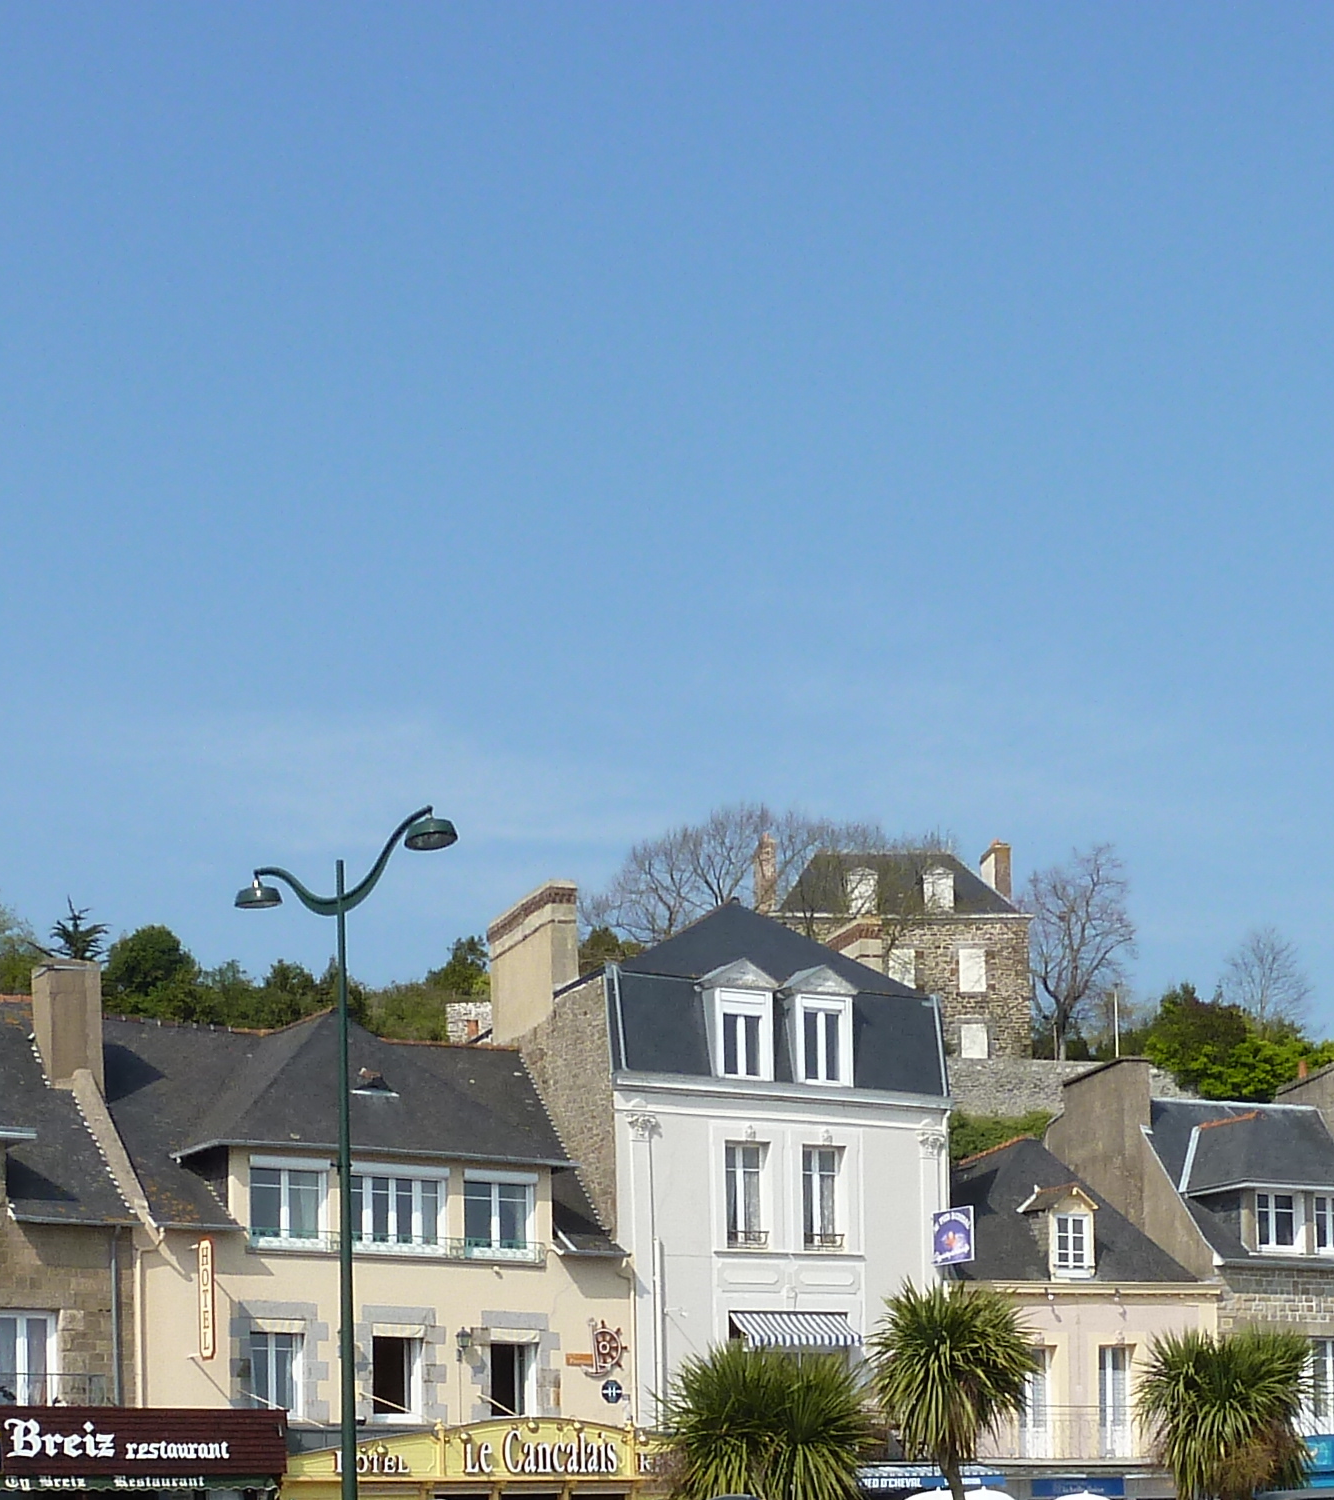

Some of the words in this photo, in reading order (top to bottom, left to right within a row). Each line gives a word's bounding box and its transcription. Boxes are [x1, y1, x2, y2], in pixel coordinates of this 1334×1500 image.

[201, 1246, 210, 1350] HOTEL
[4, 1416, 116, 1458] Breiz
[125, 1440, 230, 1460] restaurant
[465, 1438, 493, 1473] Le
[504, 1430, 617, 1474] Cancalais
